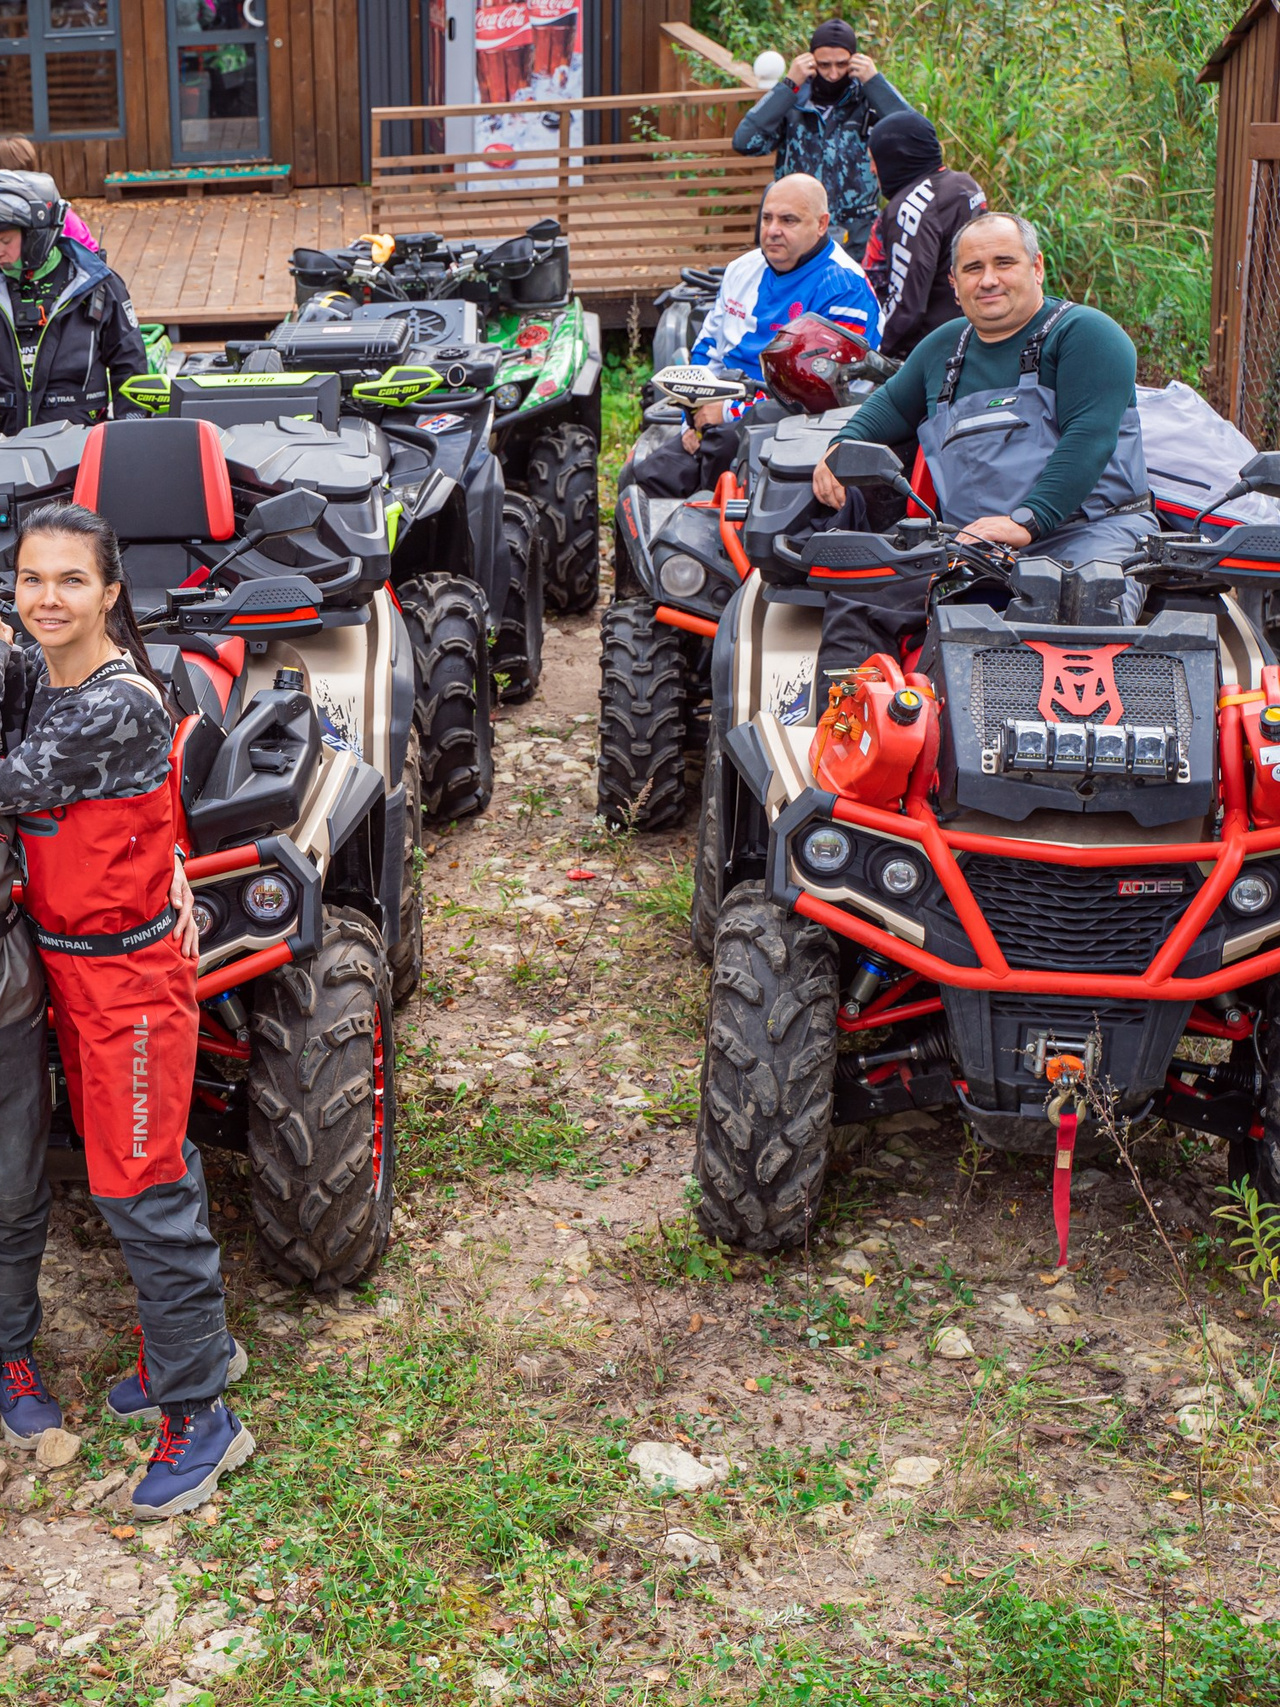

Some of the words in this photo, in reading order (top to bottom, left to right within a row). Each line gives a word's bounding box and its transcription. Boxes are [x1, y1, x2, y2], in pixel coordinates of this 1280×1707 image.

[378, 385, 420, 397] can-am
[671, 384, 716, 396] can-am
[1120, 881, 1184, 894] AODES
[122, 915, 172, 948] FINNTRAIL
[132, 1014, 149, 1159] FINNTRAIL
